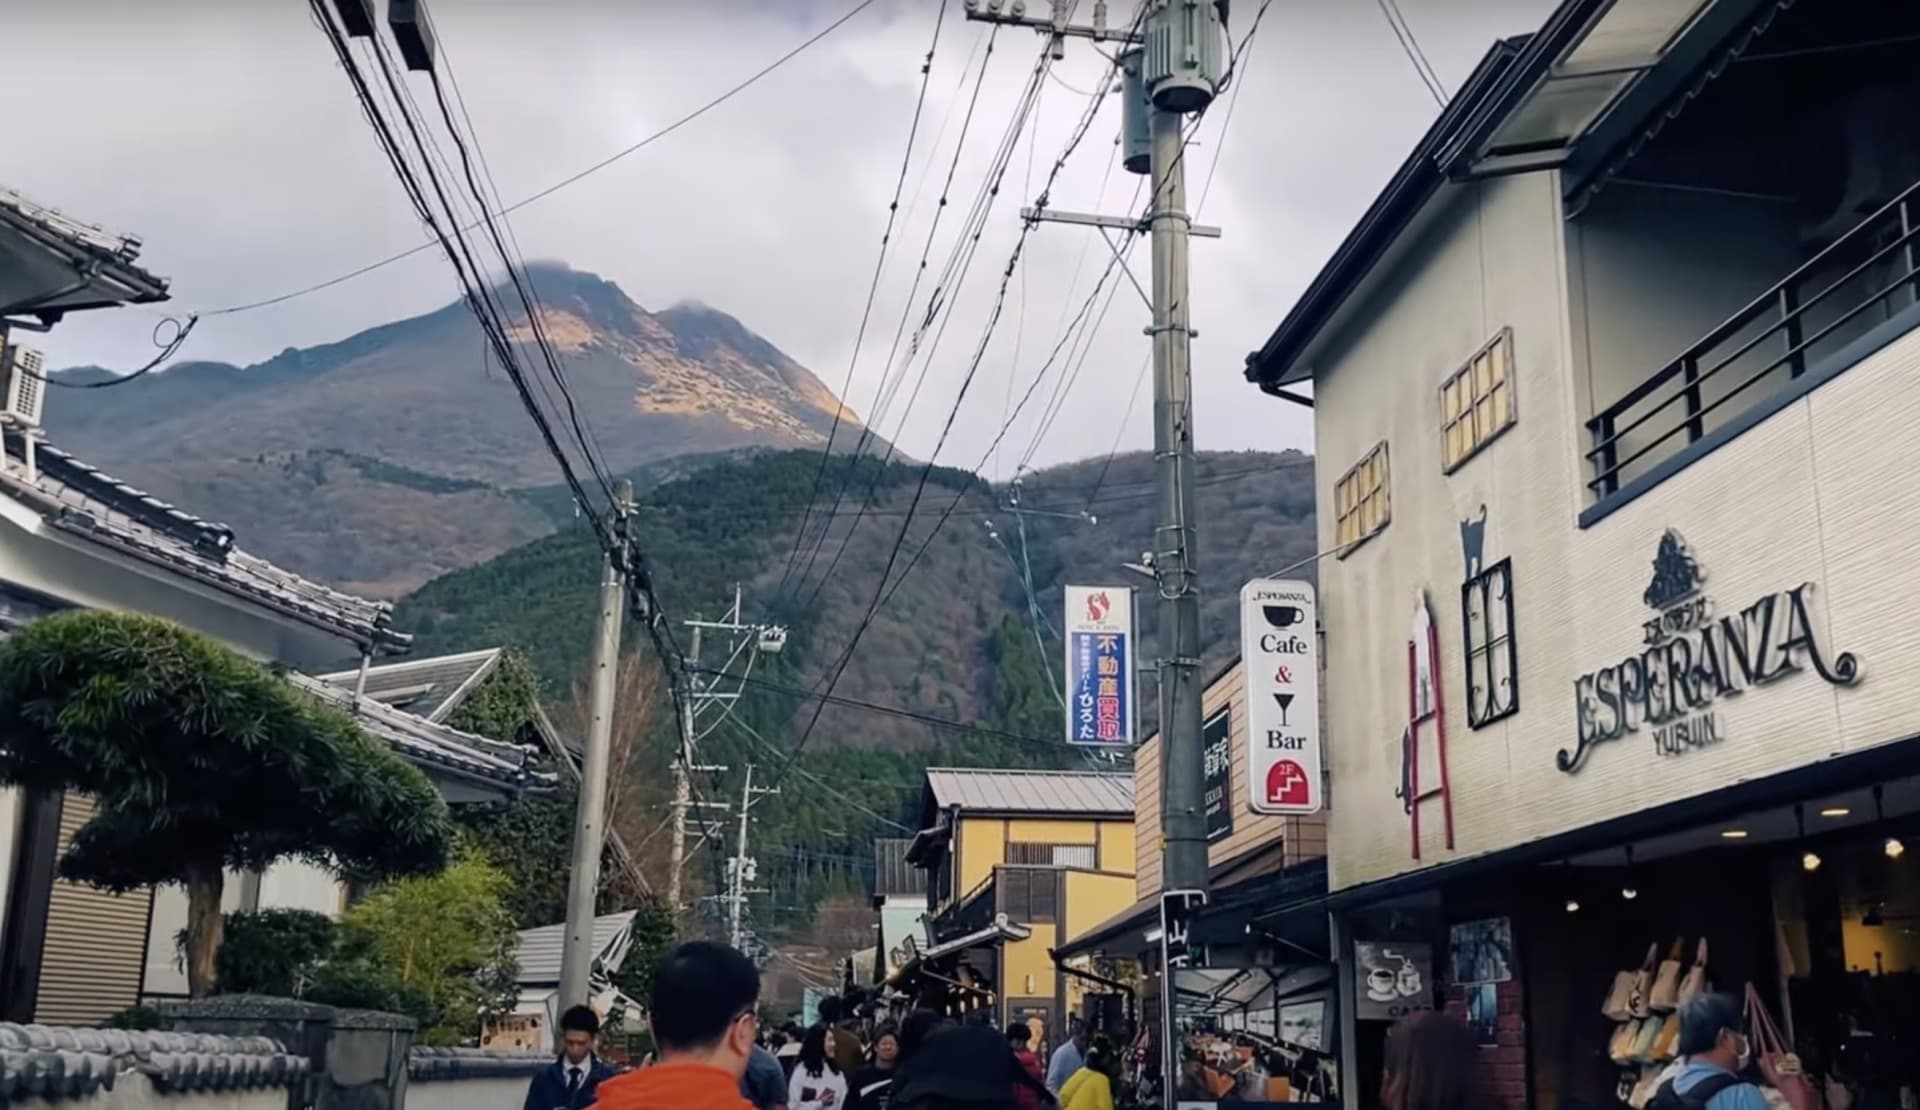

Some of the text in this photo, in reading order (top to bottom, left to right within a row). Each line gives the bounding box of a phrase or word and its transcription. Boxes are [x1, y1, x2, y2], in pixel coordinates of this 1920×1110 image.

[1260, 634, 1308, 655] Cafe
[1274, 665, 1293, 684] &
[1556, 582, 1858, 774] ESPERANZA
[1097, 634, 1120, 741] 不動産買取
[1266, 730, 1307, 750] Bar
[1279, 763, 1296, 775] 2F
